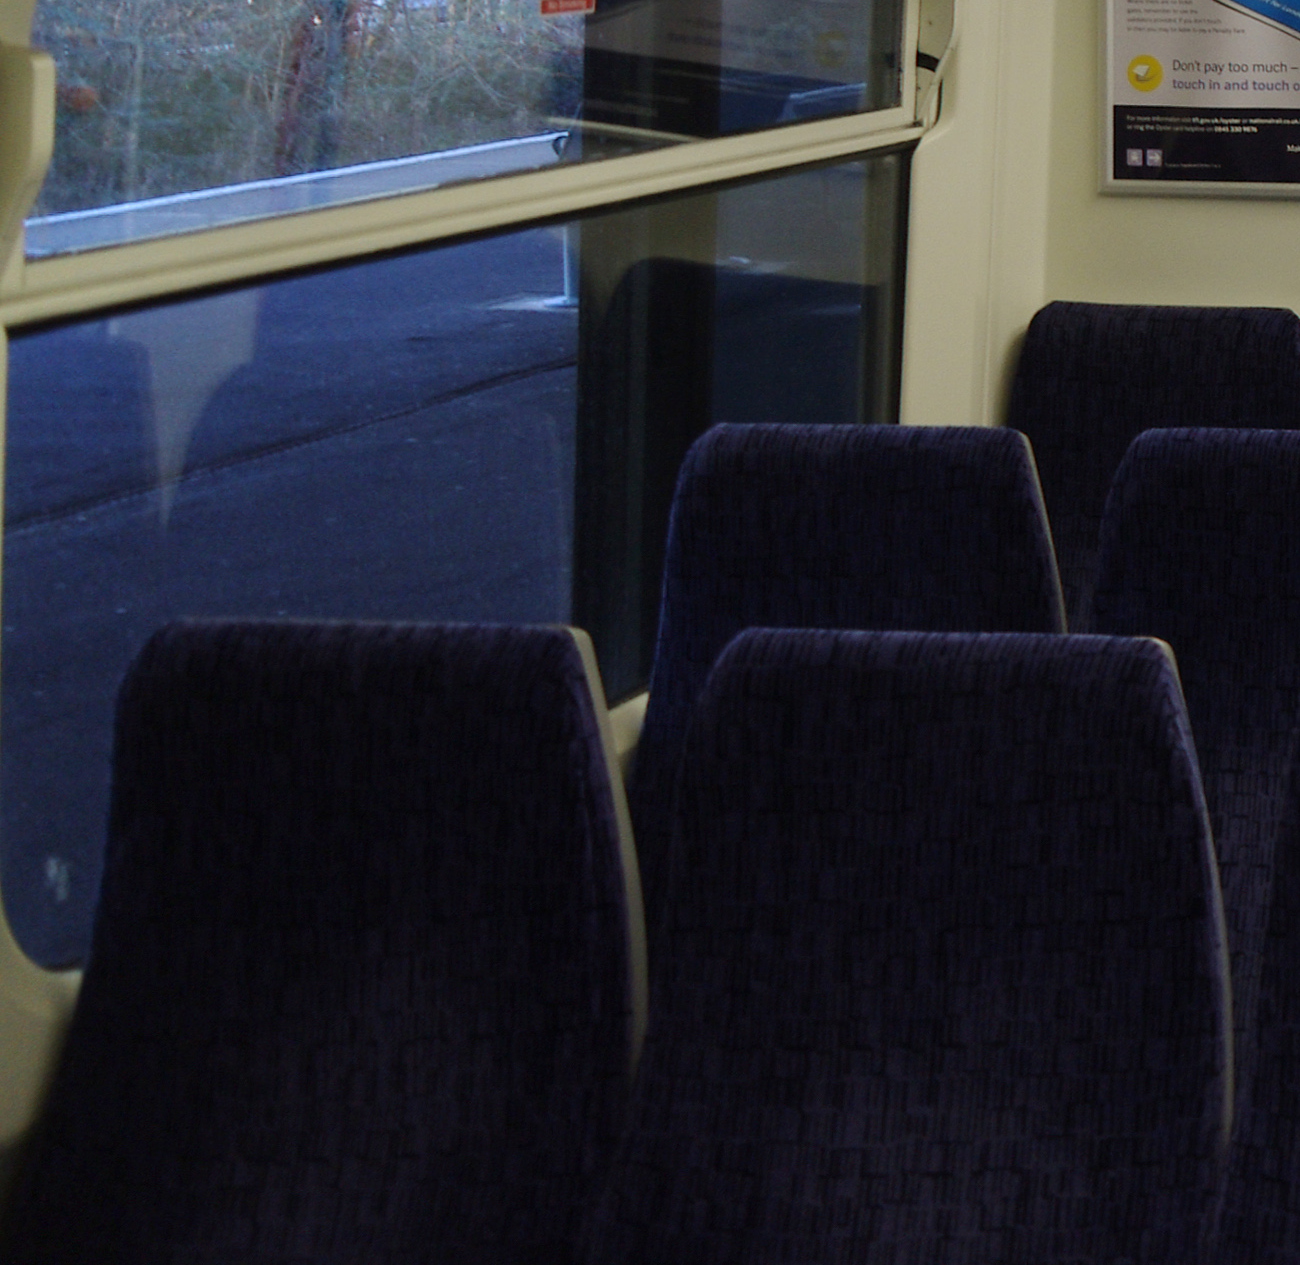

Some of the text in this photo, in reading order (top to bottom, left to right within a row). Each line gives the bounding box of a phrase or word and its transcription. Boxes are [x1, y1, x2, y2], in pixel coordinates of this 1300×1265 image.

[1172, 59, 1201, 72] Don't
[1204, 62, 1225, 75] pay
[1228, 62, 1249, 73] too
[1252, 61, 1288, 73] much
[1172, 79, 1205, 90] touch
[1208, 79, 1221, 91] in
[1224, 79, 1249, 91] and
[1252, 80, 1290, 91] touch
